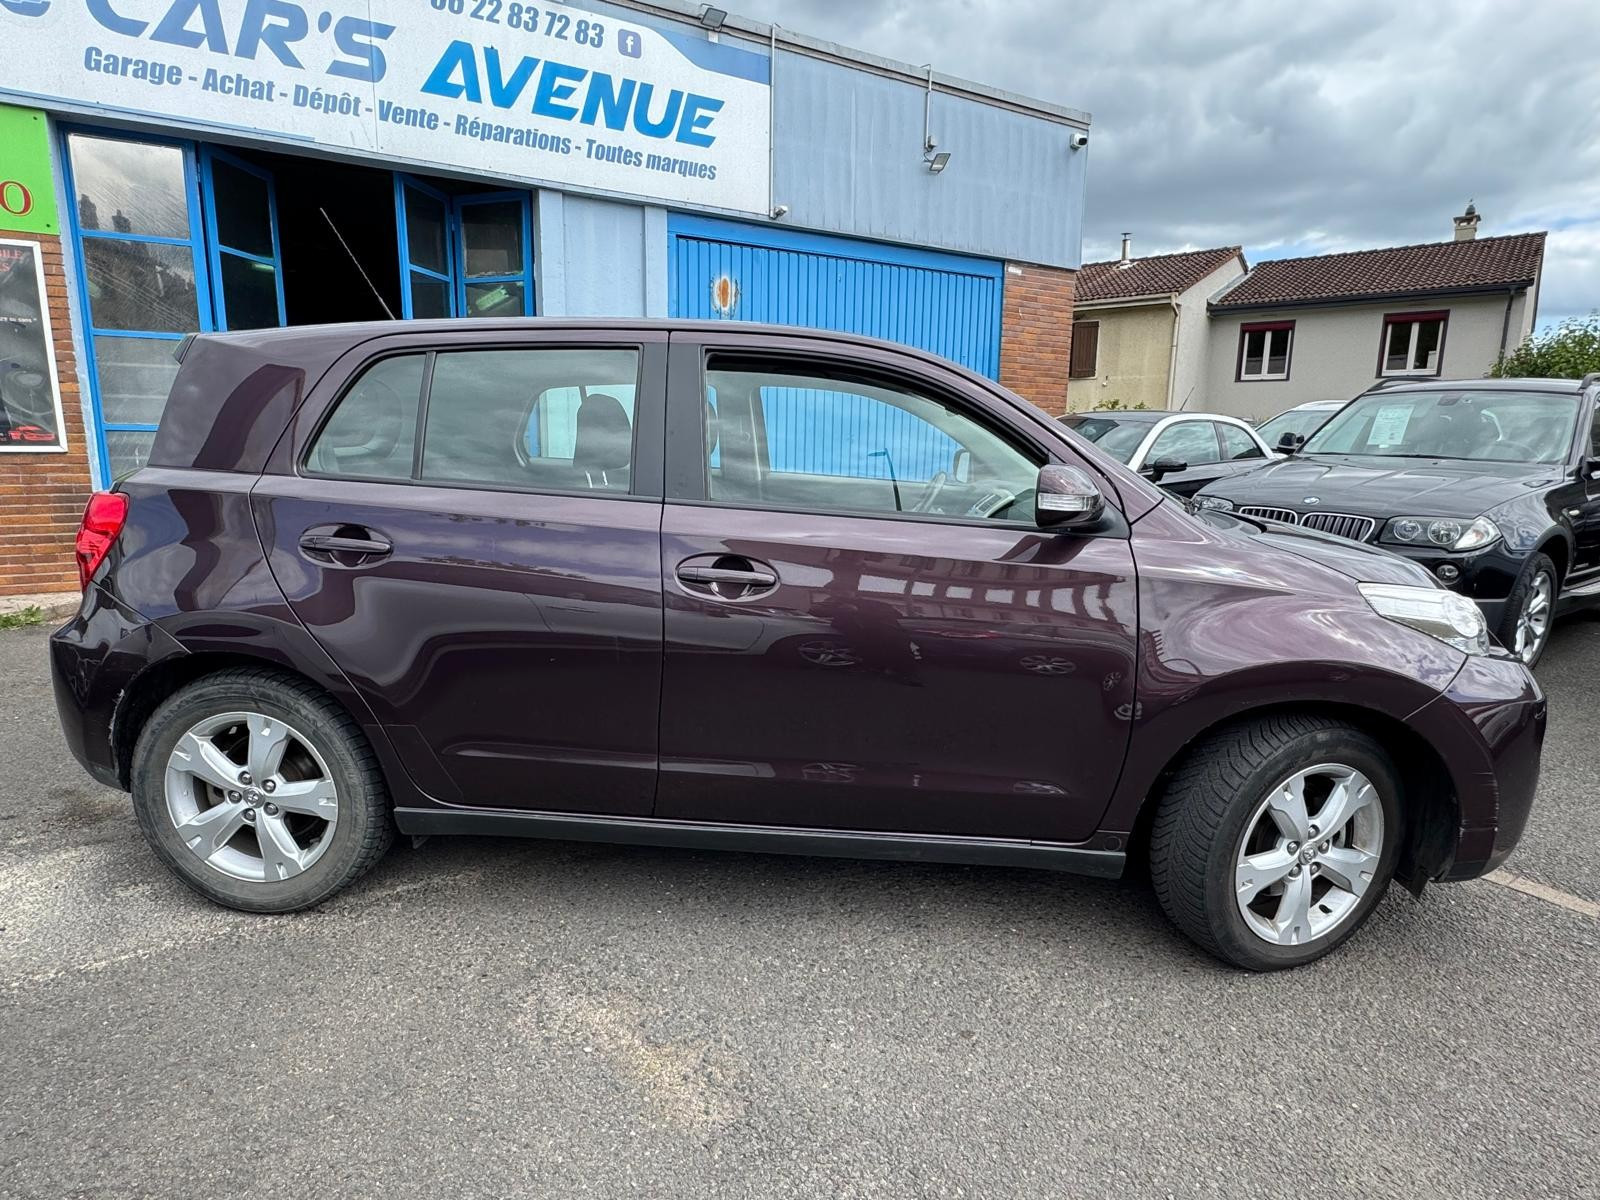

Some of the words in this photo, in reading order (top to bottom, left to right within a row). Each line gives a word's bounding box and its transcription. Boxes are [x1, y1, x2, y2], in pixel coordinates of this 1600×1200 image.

[85, 0, 396, 84] CAR'S
[469, 0, 502, 24] 22
[507, 2, 540, 33] 83
[545, 10, 571, 41] 72
[574, 19, 604, 48] 83
[84, 46, 183, 85] Garage
[201, 67, 275, 102] Achat
[293, 84, 361, 117] Dépôt
[378, 99, 439, 131] Vente
[455, 113, 571, 155] Réparations
[586, 138, 643, 167] Toutes
[646, 153, 716, 180] marques
[420, 39, 725, 148] AVENUE
